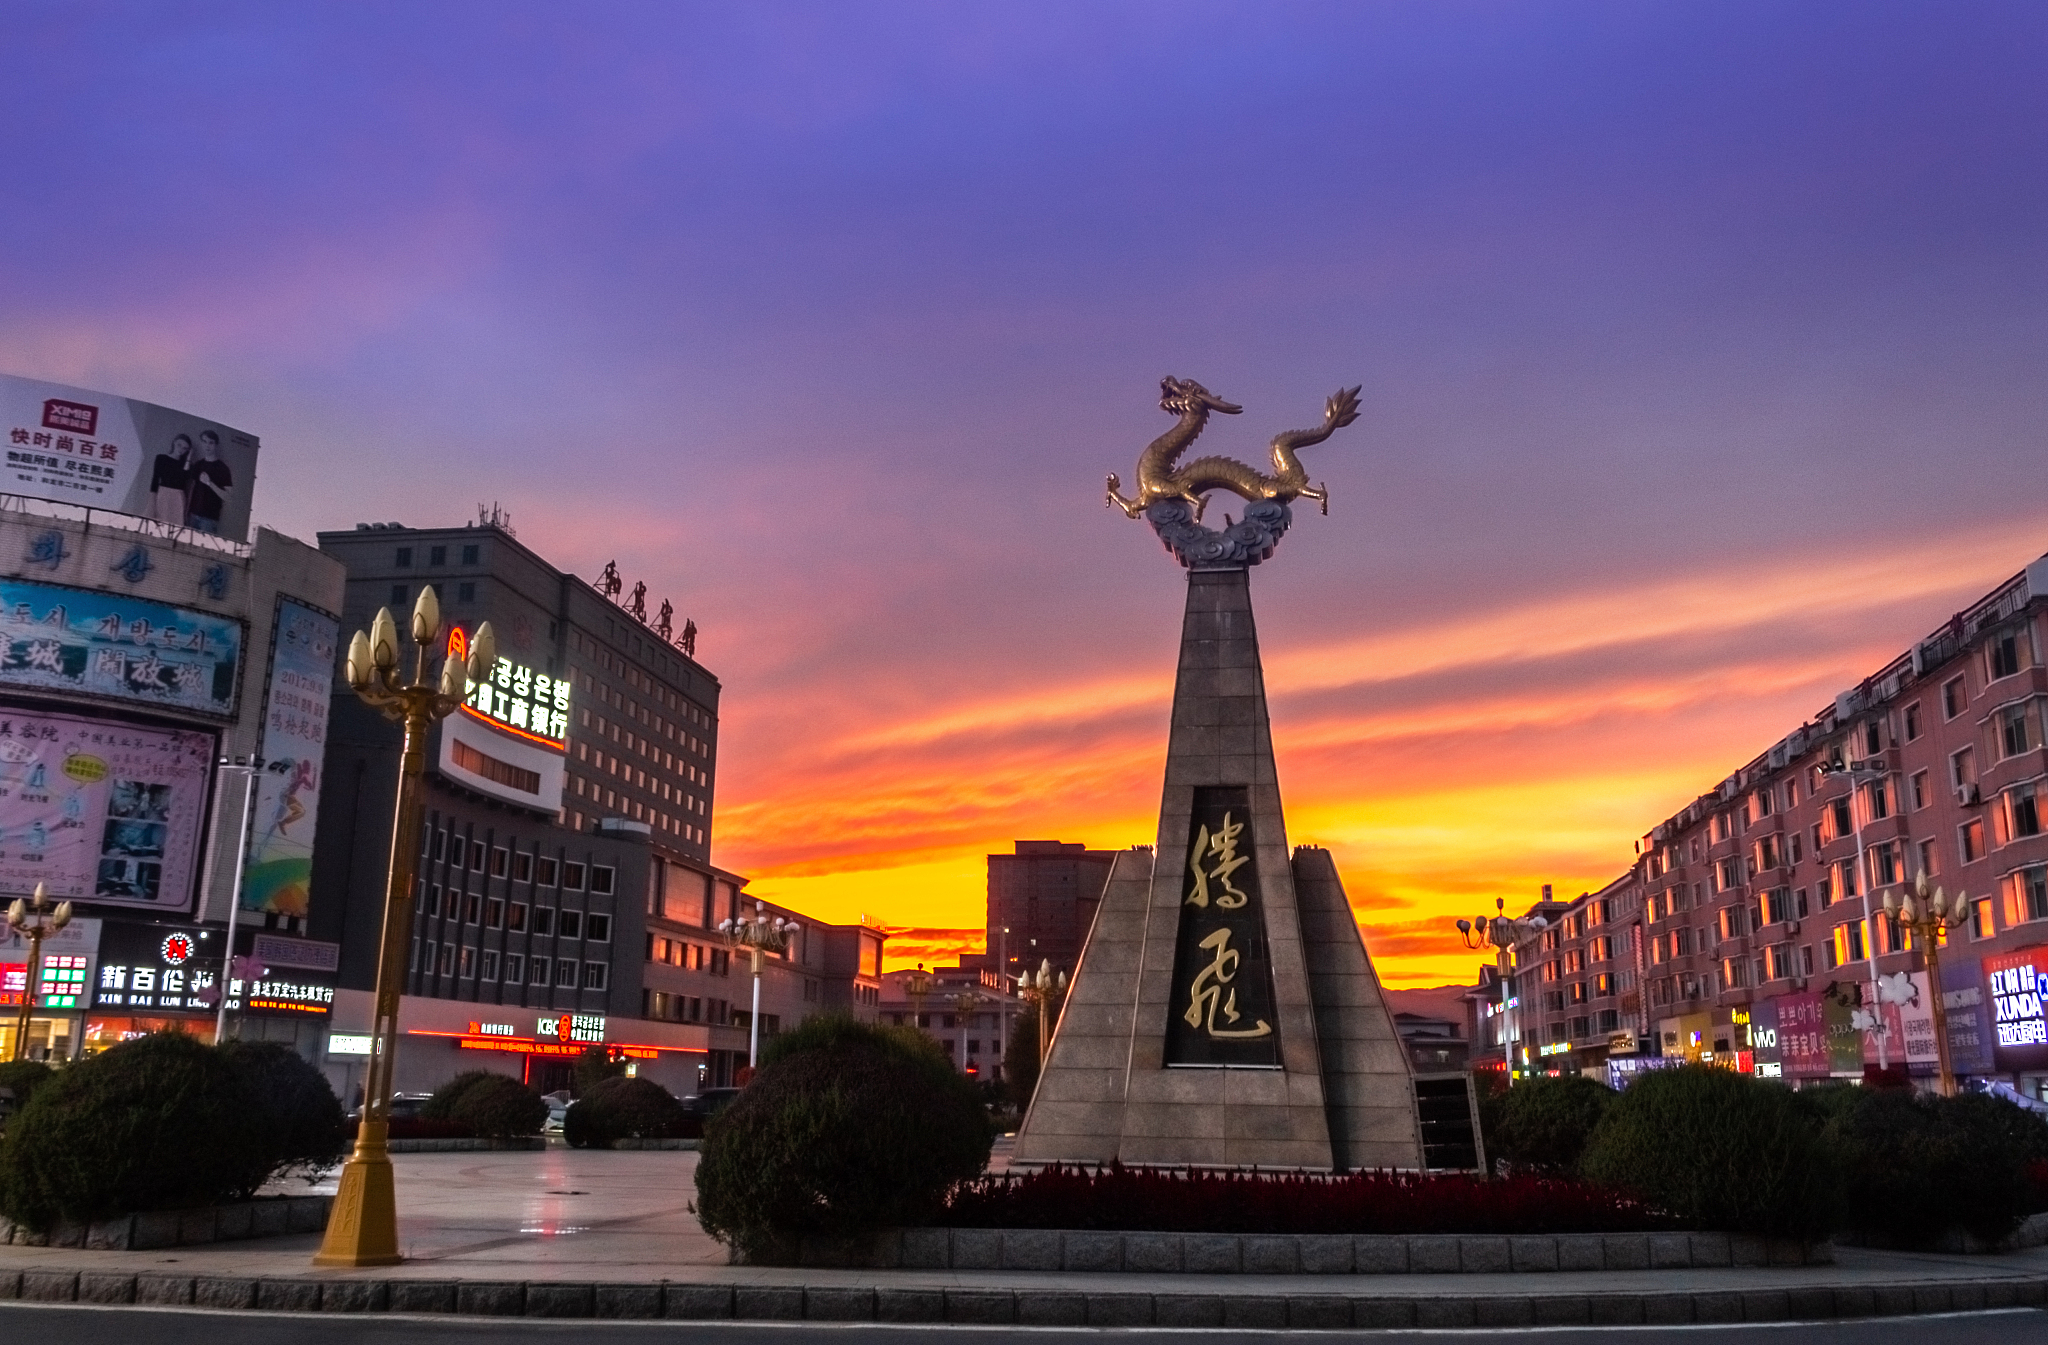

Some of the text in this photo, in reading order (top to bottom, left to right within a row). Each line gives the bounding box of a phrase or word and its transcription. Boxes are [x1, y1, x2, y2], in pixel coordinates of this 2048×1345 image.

[10, 427, 119, 461] 快时尚百货
[7, 451, 59, 469] 物超所值
[97, 612, 207, 655] 개방도시
[280, 671, 325, 696] 2017.9.9
[271, 709, 324, 743] 鸣枪起跑
[99, 994, 123, 1004] XIN
[129, 995, 153, 1005] BAI
[160, 996, 181, 1007] LUN
[1994, 992, 2044, 1022] XUNDA
[537, 1018, 560, 1035] ICBC
[1754, 1025, 1777, 1048] vivo
